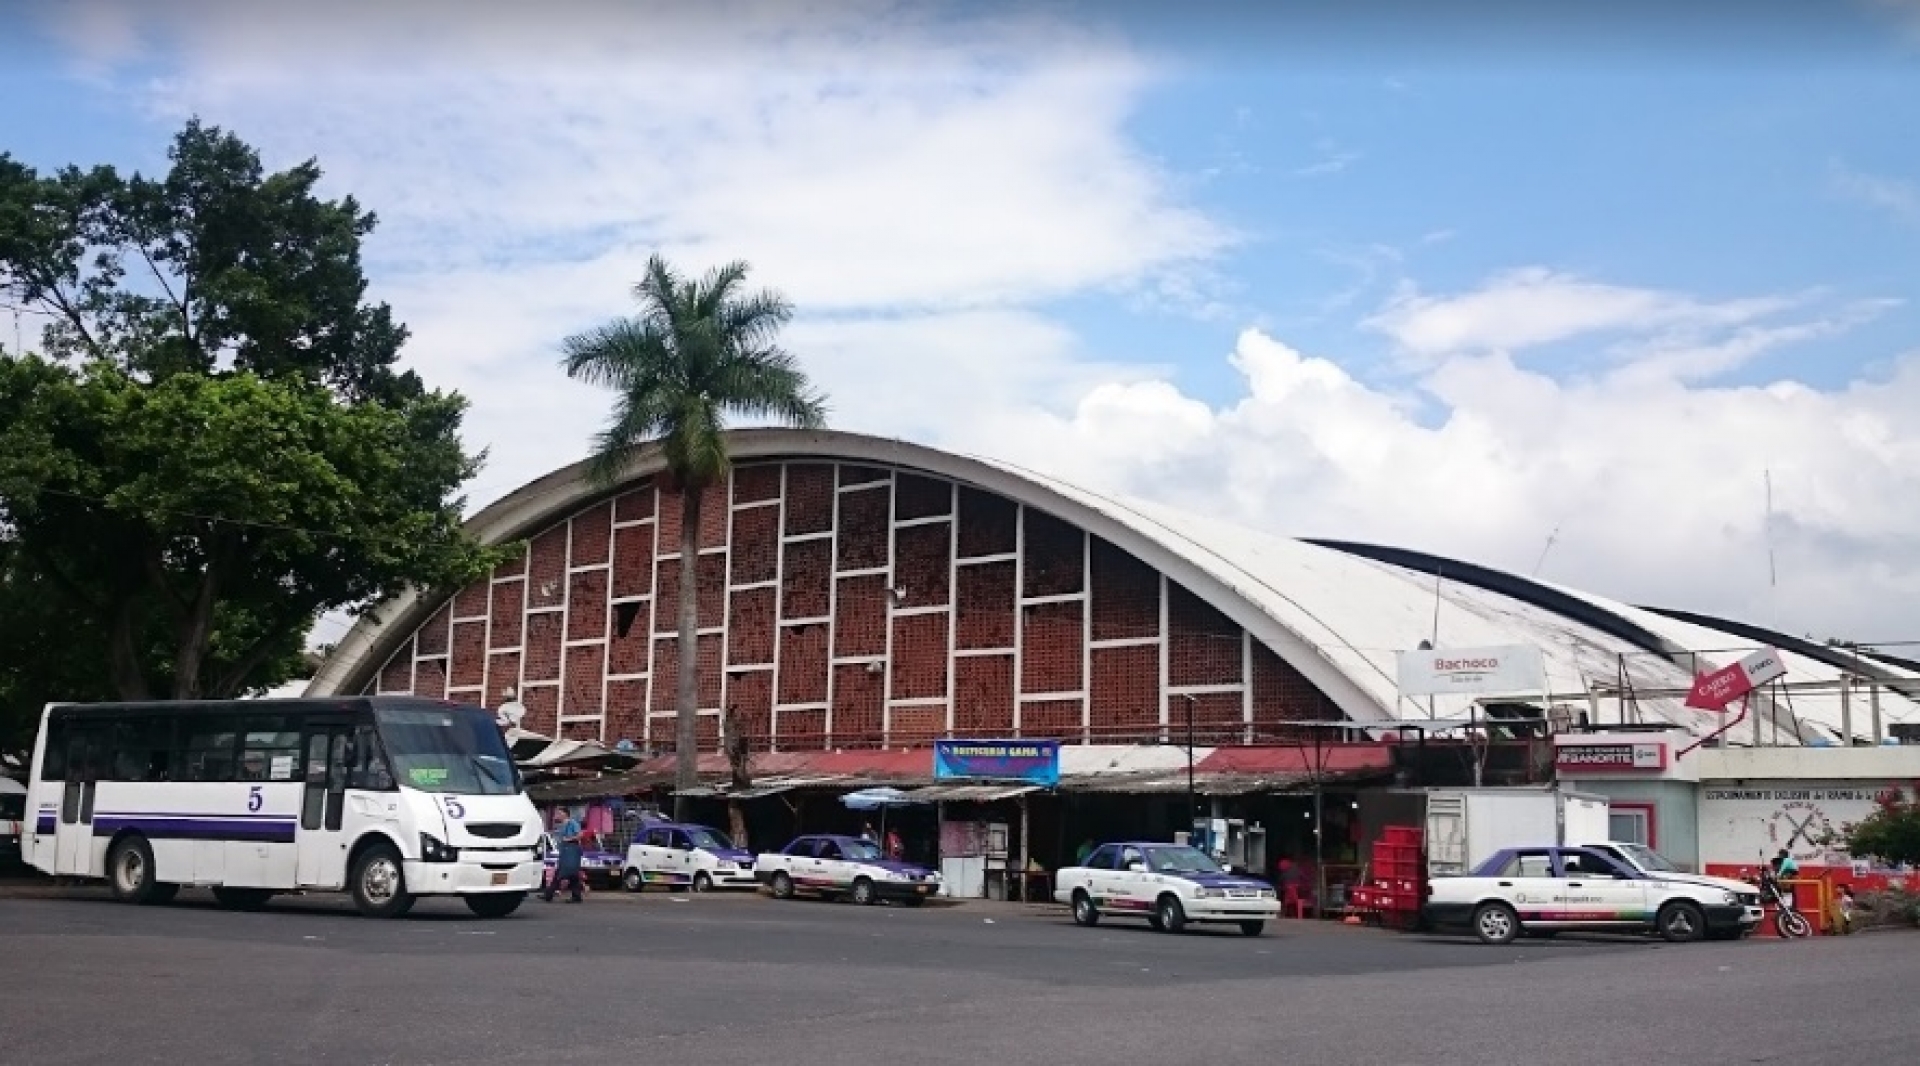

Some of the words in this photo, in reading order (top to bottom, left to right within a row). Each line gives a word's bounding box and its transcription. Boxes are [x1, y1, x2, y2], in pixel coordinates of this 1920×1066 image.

[1434, 658, 1499, 670] Bachoco
[248, 786, 263, 813] 5
[443, 796, 466, 819] 5
